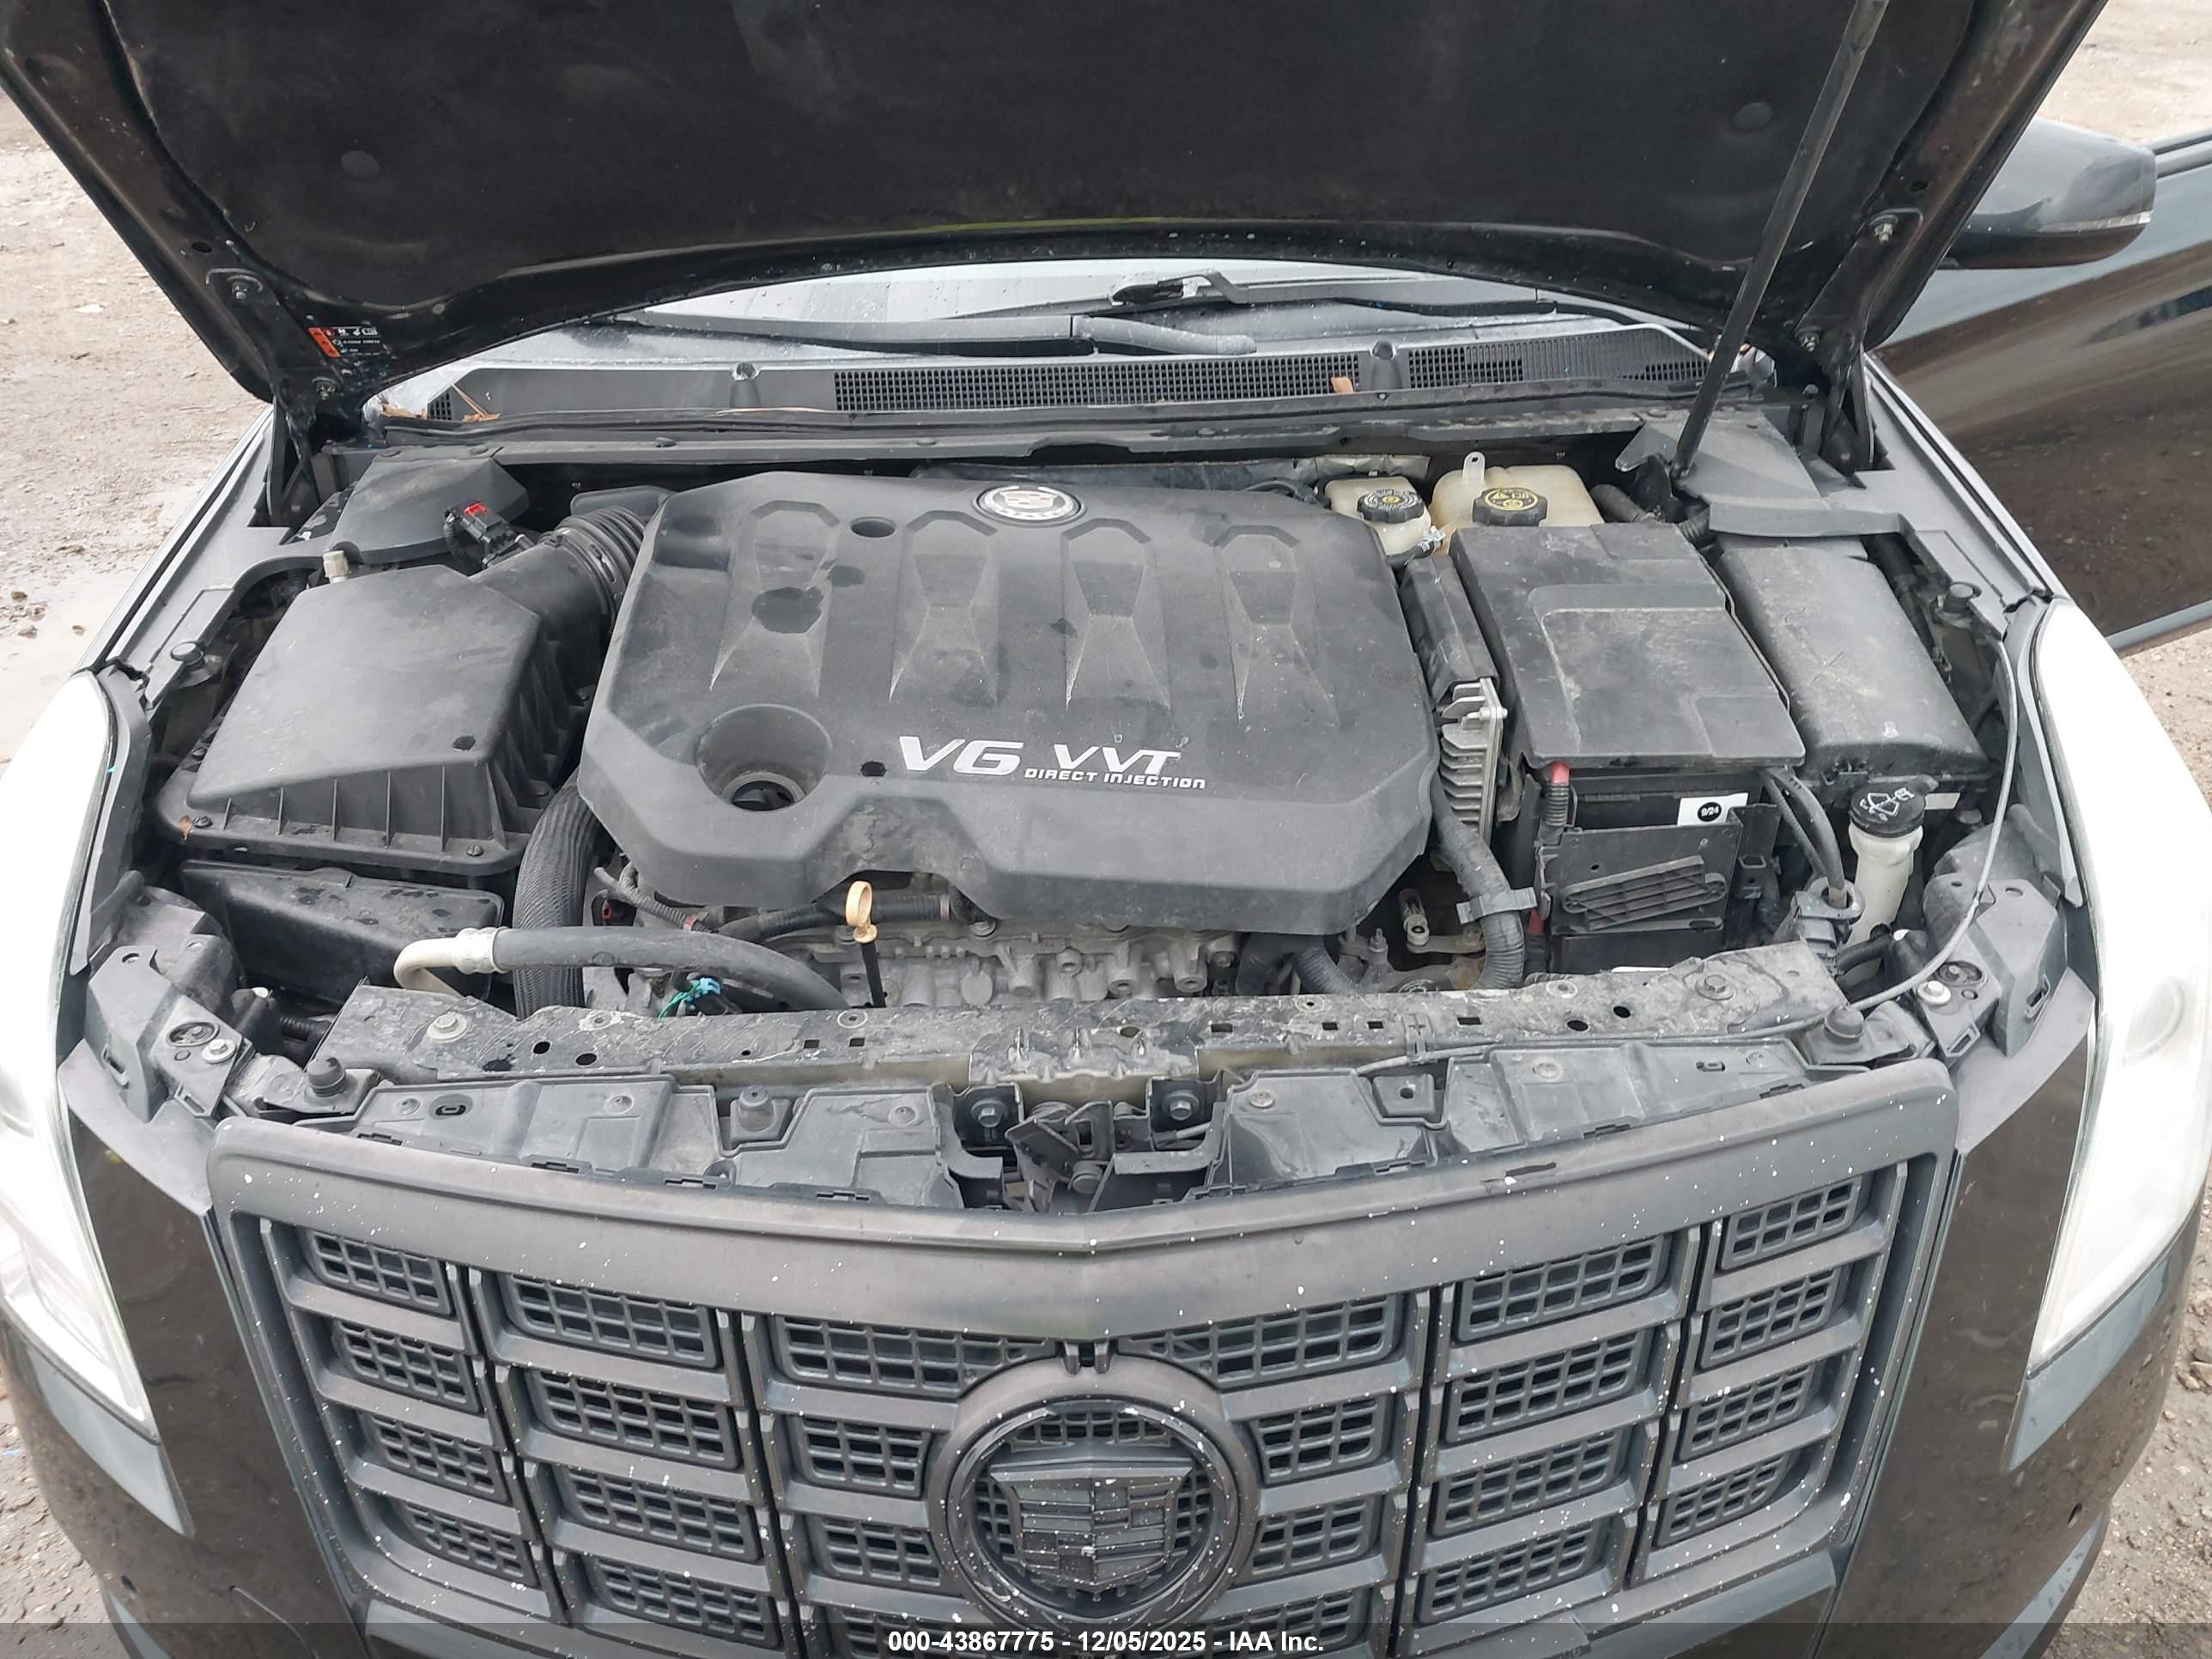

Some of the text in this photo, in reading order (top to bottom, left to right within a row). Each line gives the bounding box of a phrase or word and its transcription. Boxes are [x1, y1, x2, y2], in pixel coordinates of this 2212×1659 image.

[899, 736, 1182, 775] V6 VVT
[1024, 769, 1206, 790] DIRECT INJECTION
